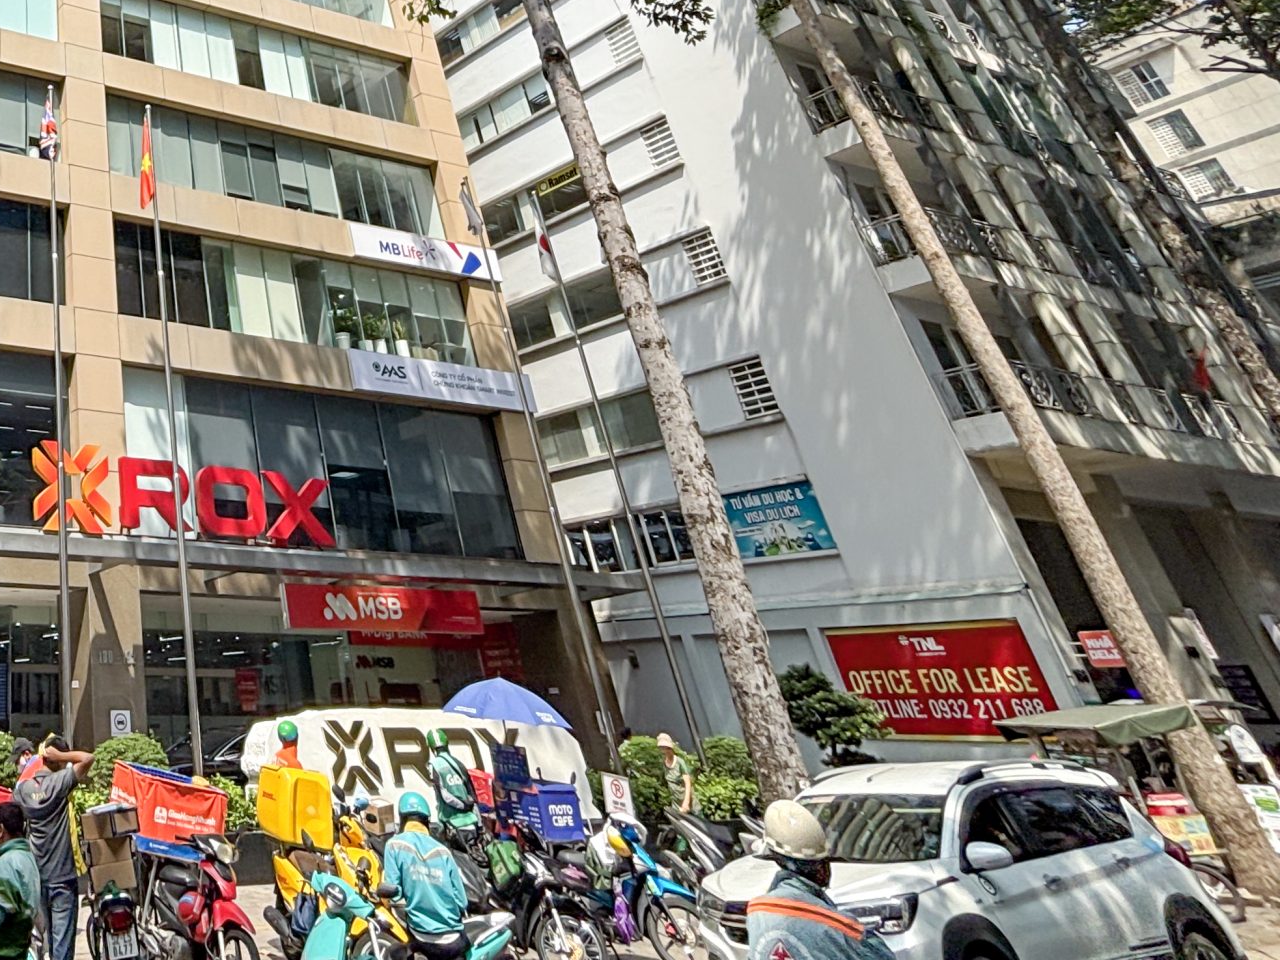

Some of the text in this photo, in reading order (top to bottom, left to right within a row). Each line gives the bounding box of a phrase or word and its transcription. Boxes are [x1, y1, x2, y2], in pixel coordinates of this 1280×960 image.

[118, 456, 338, 549] ROX
[744, 511, 765, 524] VISA
[767, 508, 780, 520] DU
[358, 596, 403, 620] MSB
[909, 636, 945, 652] TNL
[848, 666, 1039, 695] OFFICE FOR LEASE
[869, 698, 1046, 720] OTLINE: 0932 211 688
[548, 804, 573, 816] MOTO
[552, 815, 574, 827] CAFE
